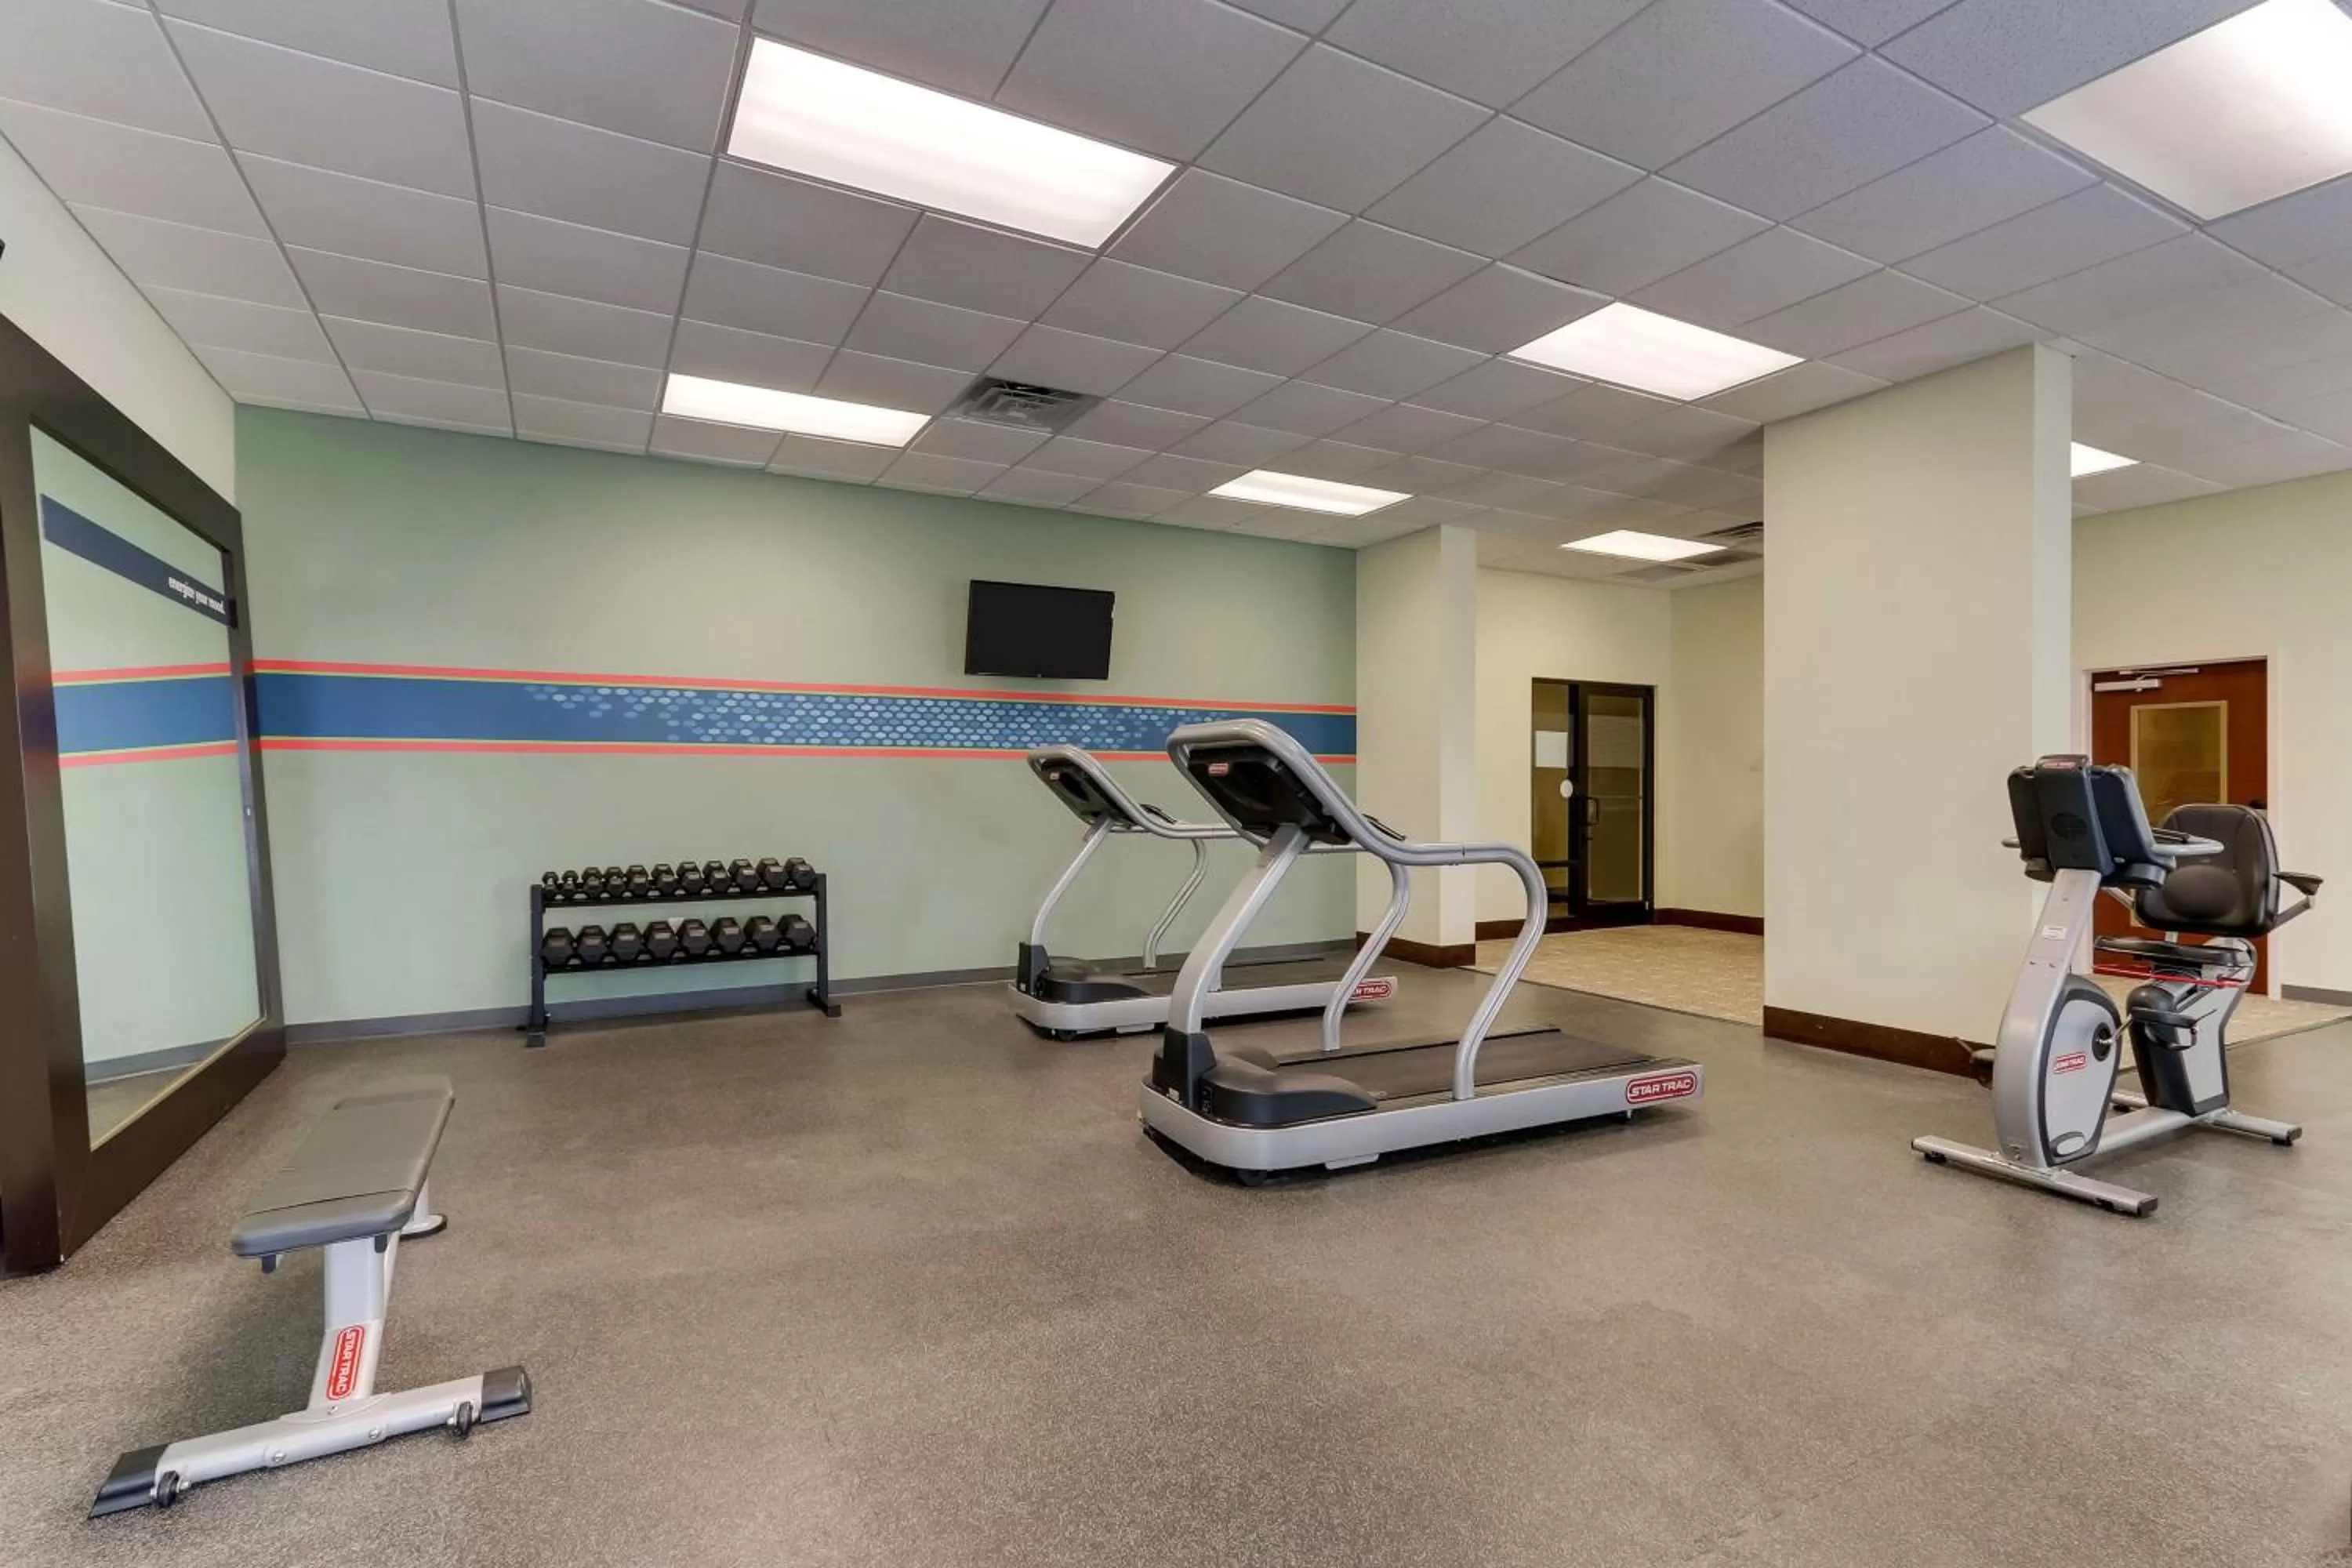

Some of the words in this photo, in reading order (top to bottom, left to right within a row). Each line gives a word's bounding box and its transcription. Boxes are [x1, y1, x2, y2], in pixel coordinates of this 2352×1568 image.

[1632, 1084, 1660, 1096] STAR
[1661, 1078, 1692, 1092] TRAC
[343, 1330, 357, 1360] STAR
[336, 1359, 352, 1393] TRAC
